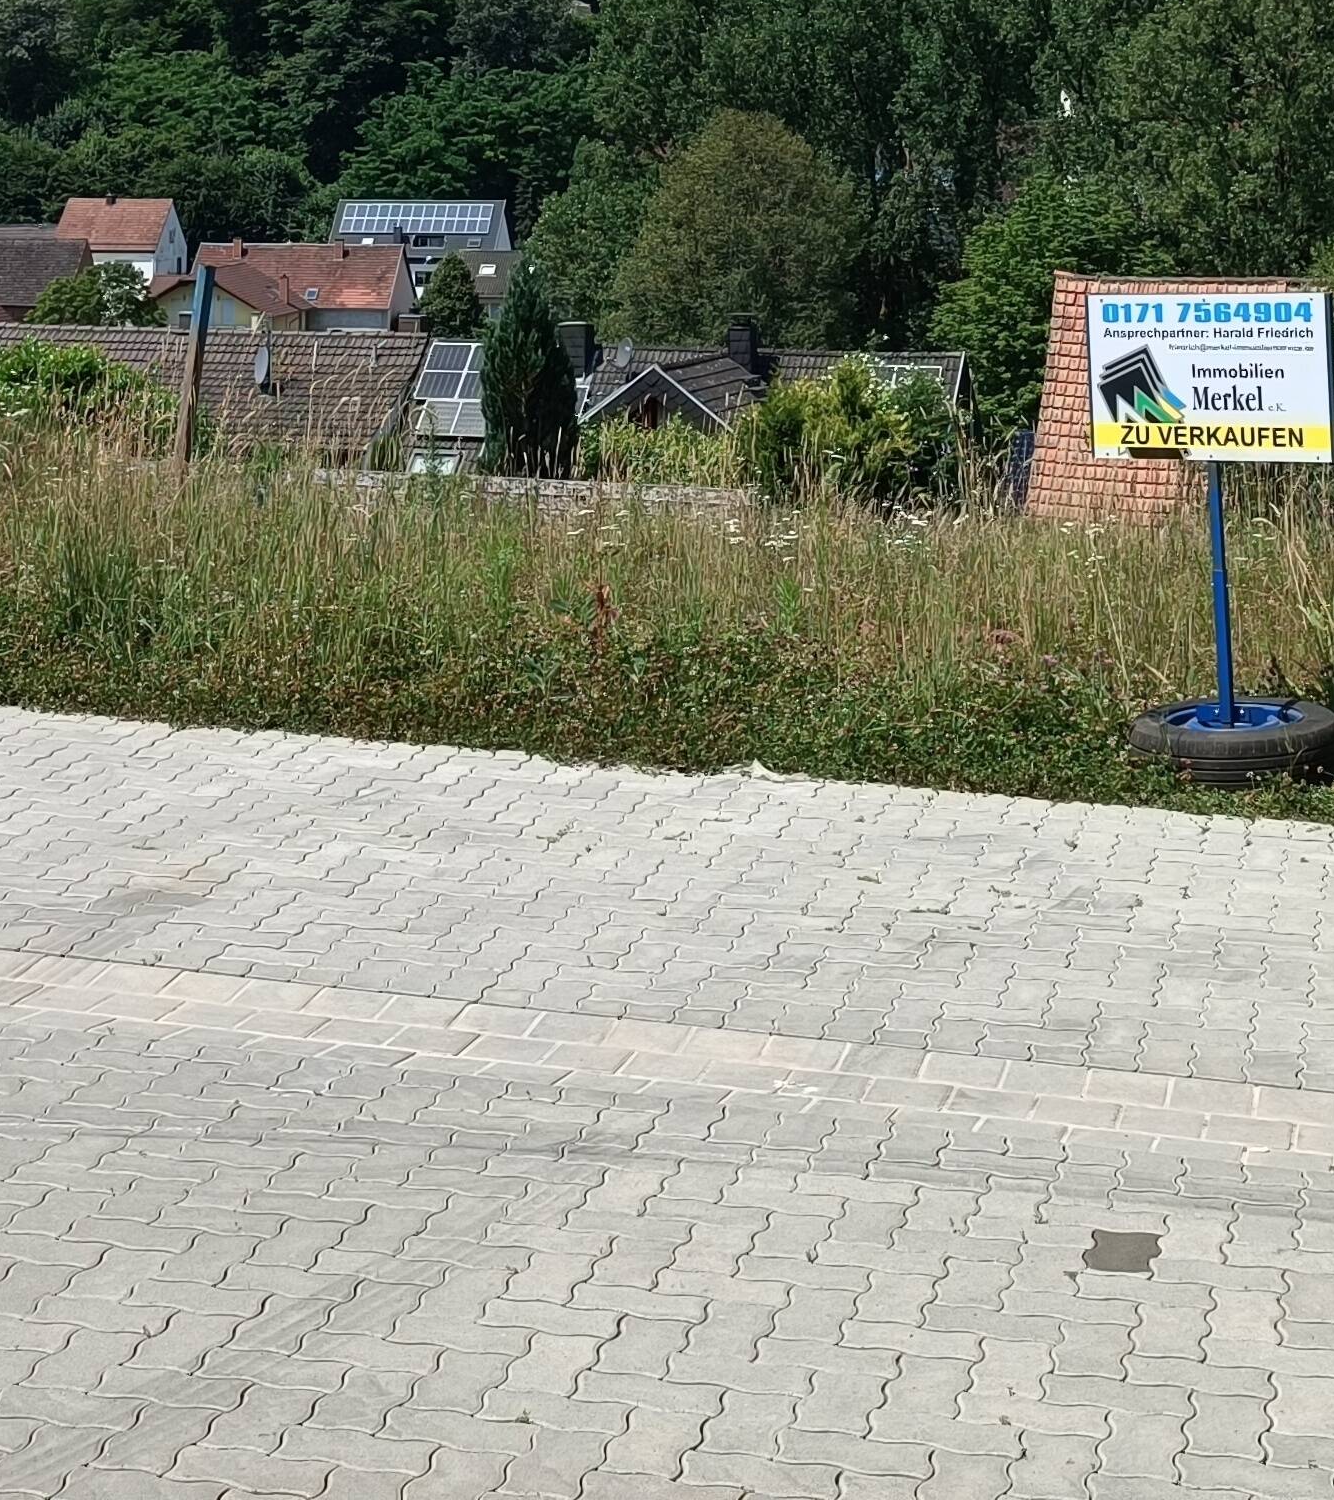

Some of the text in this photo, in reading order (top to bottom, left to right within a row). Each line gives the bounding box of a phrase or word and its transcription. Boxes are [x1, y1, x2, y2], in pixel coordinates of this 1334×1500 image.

[1102, 302, 1313, 323] 0171 7564904
[1103, 327, 1314, 340] Ansprechpartner: Harald Friedrich
[1191, 363, 1285, 379] Immobilien
[1192, 385, 1264, 411] Merkel
[1120, 425, 1304, 448] ZU VERKAUFEN
